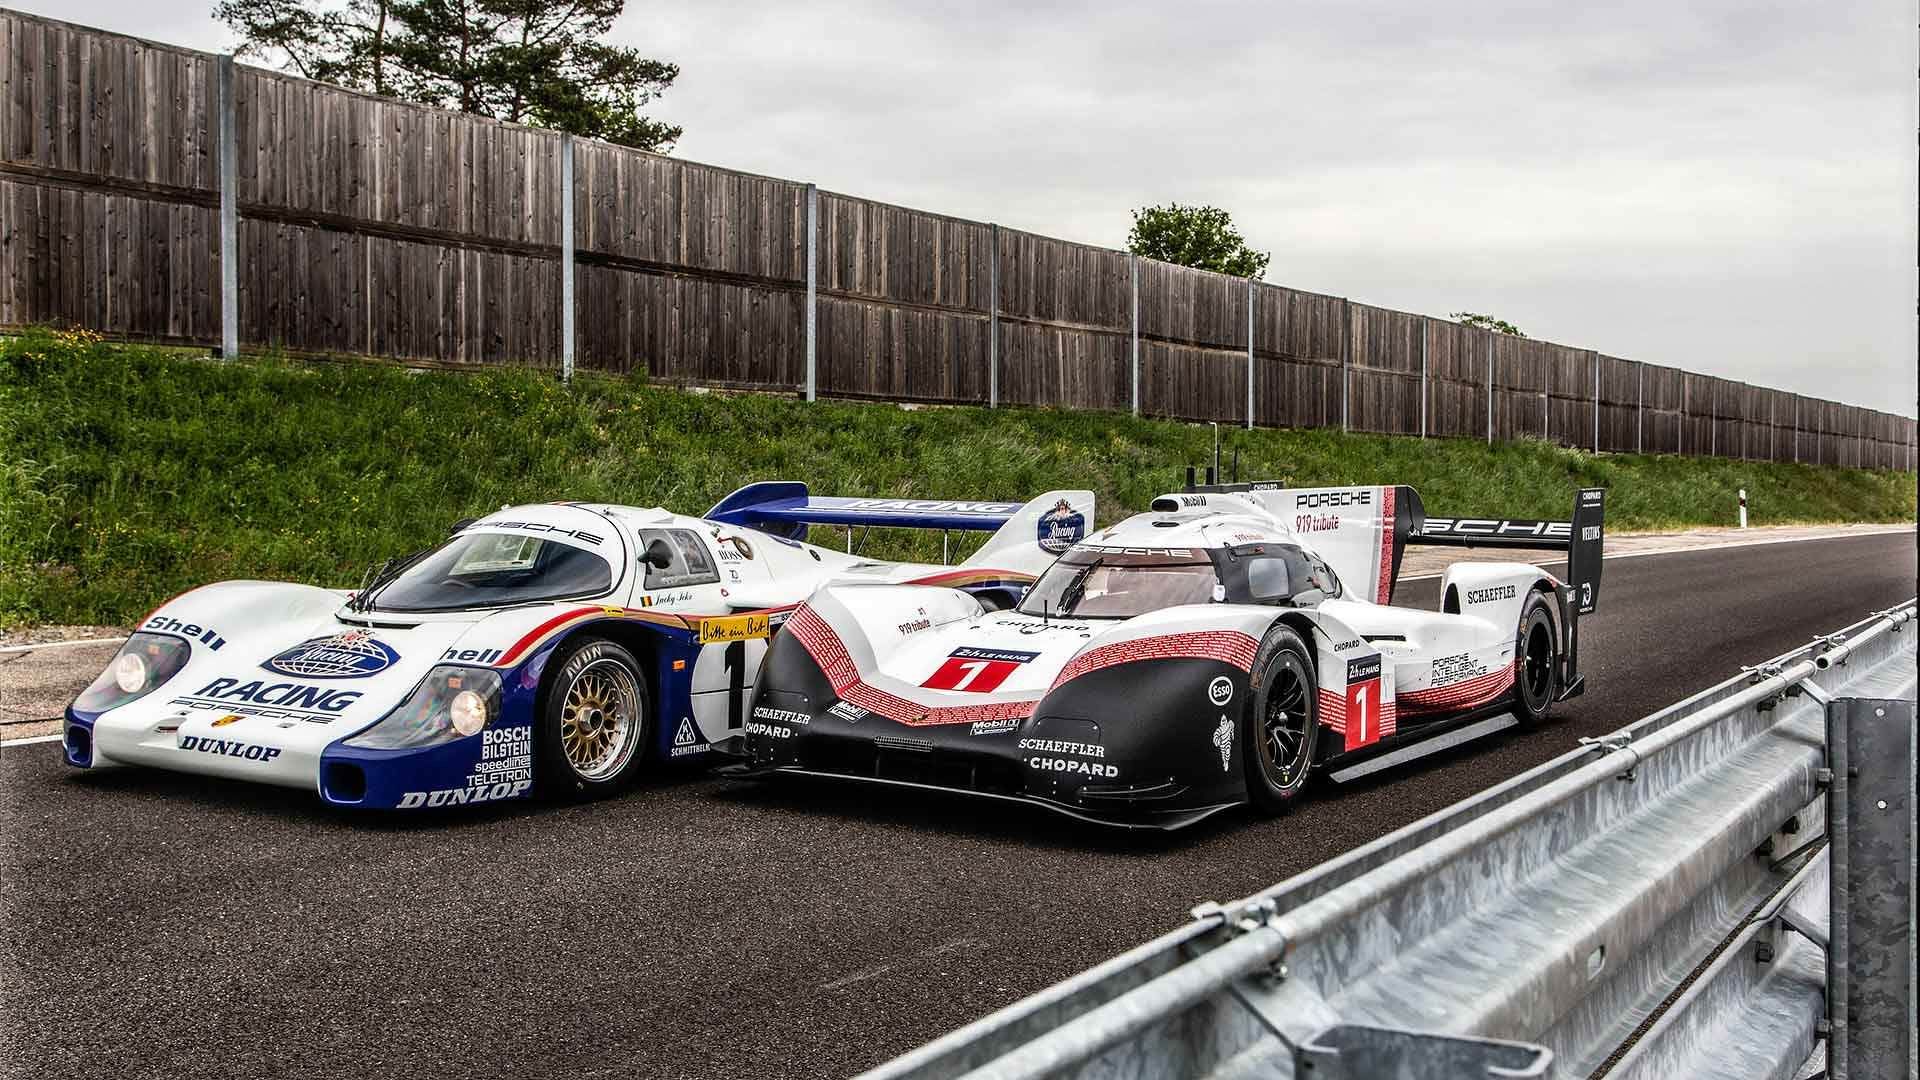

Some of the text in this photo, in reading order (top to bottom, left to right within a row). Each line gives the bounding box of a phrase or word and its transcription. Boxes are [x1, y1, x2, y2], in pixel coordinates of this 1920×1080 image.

[847, 500, 1009, 513] RACING
[1296, 491, 1371, 509] PORSCHE
[1048, 521, 1076, 540] Racing
[1296, 514, 1339, 534] 919 tribute
[1467, 584, 1516, 605] SCHAEFFLER
[146, 616, 227, 651] Shell
[703, 621, 725, 640] Bitte
[729, 628, 744, 638] ein
[747, 617, 769, 635] Bit!
[898, 619, 931, 635] 919 tribute
[1334, 639, 1360, 652] CHOPARD
[1366, 664, 1380, 675] MANS
[1431, 659, 1479, 678] INTELLIGENT
[1432, 652, 1470, 669] PORSCHE
[724, 640, 746, 730] 1
[952, 662, 992, 690] 1
[1430, 666, 1488, 687] PERFORMANCE
[192, 678, 364, 712] RACING
[166, 699, 336, 725] PORSCHE
[753, 706, 811, 725] SCHAEFFLER
[1355, 686, 1368, 743] 1
[745, 722, 791, 739] CHOPARD
[972, 720, 1007, 729] Mobil
[482, 726, 531, 745] BOSCH
[177, 735, 282, 763] DUNLOP
[482, 741, 530, 760] BILSTEIN
[1018, 738, 1105, 758] SCHAEFFLER
[475, 757, 530, 773] speedline
[1030, 756, 1119, 778] CHOPARD
[466, 768, 532, 787] TELETRON
[396, 780, 532, 809] DUNLOP
